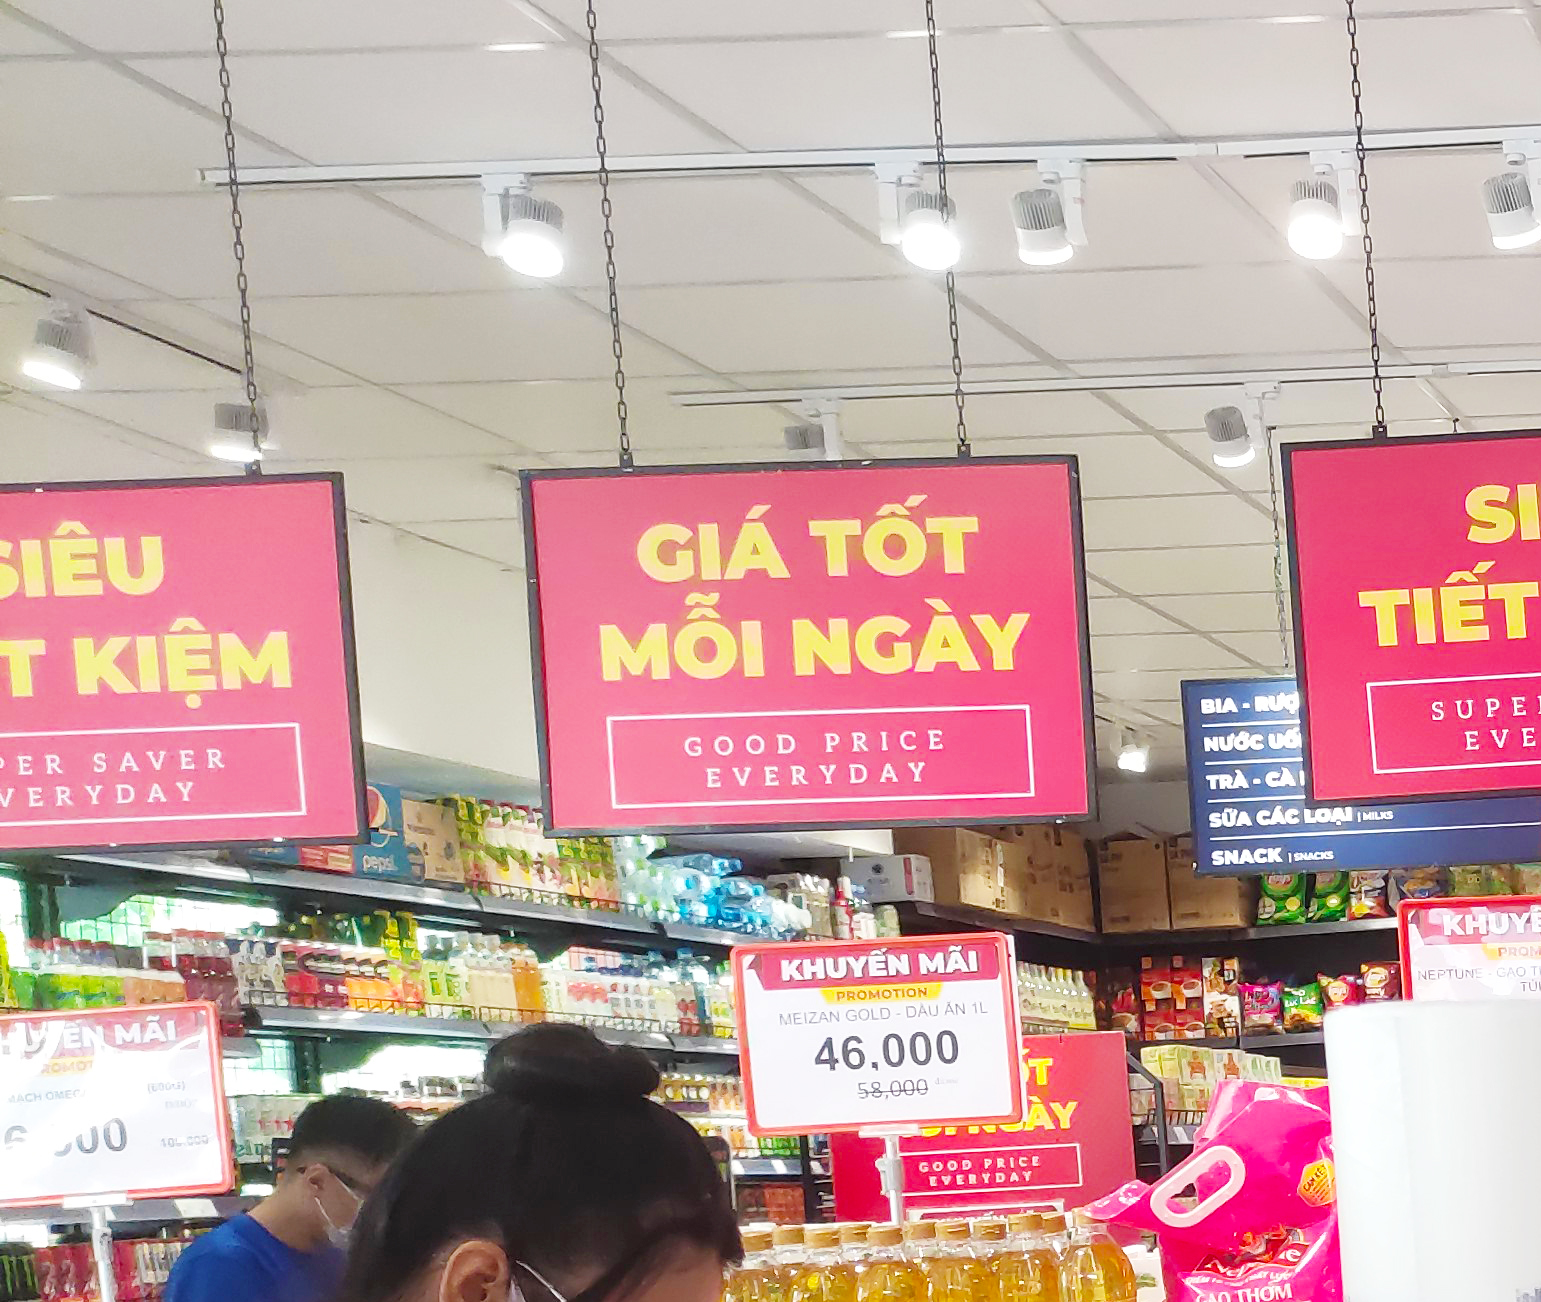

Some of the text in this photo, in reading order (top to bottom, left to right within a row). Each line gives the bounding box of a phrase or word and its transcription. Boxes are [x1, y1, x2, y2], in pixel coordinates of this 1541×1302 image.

[636, 494, 979, 583] GIÁ TỐT
[1358, 561, 1540, 647] TIẾT
[600, 592, 1030, 682] MỖI NGÀY
[73, 617, 292, 709] KIỆM
[1200, 691, 1300, 715] BIA RƯỢ
[684, 730, 947, 758] GOOD PRICE
[1204, 731, 1265, 752] NƯỚC
[93, 748, 225, 774] SAVER
[706, 761, 928, 789] EVERYDAY
[1205, 767, 1295, 790] TRÀ CÀ
[1209, 807, 1252, 828] SỮA
[1256, 805, 1300, 826] CÁC
[1304, 807, 1353, 826] LOẠI
[1211, 845, 1334, 867] SNACK SNACKS
[781, 945, 979, 983] KHUYẾN MÃI
[836, 987, 928, 1002] PROMOTION
[779, 1010, 840, 1026] MEIZAN
[845, 1007, 891, 1022] GOLD
[115, 1015, 177, 1046] MÃI
[919, 1155, 1041, 1174] GOOD PRICE
[929, 1171, 1033, 1187] EVERYDAY
